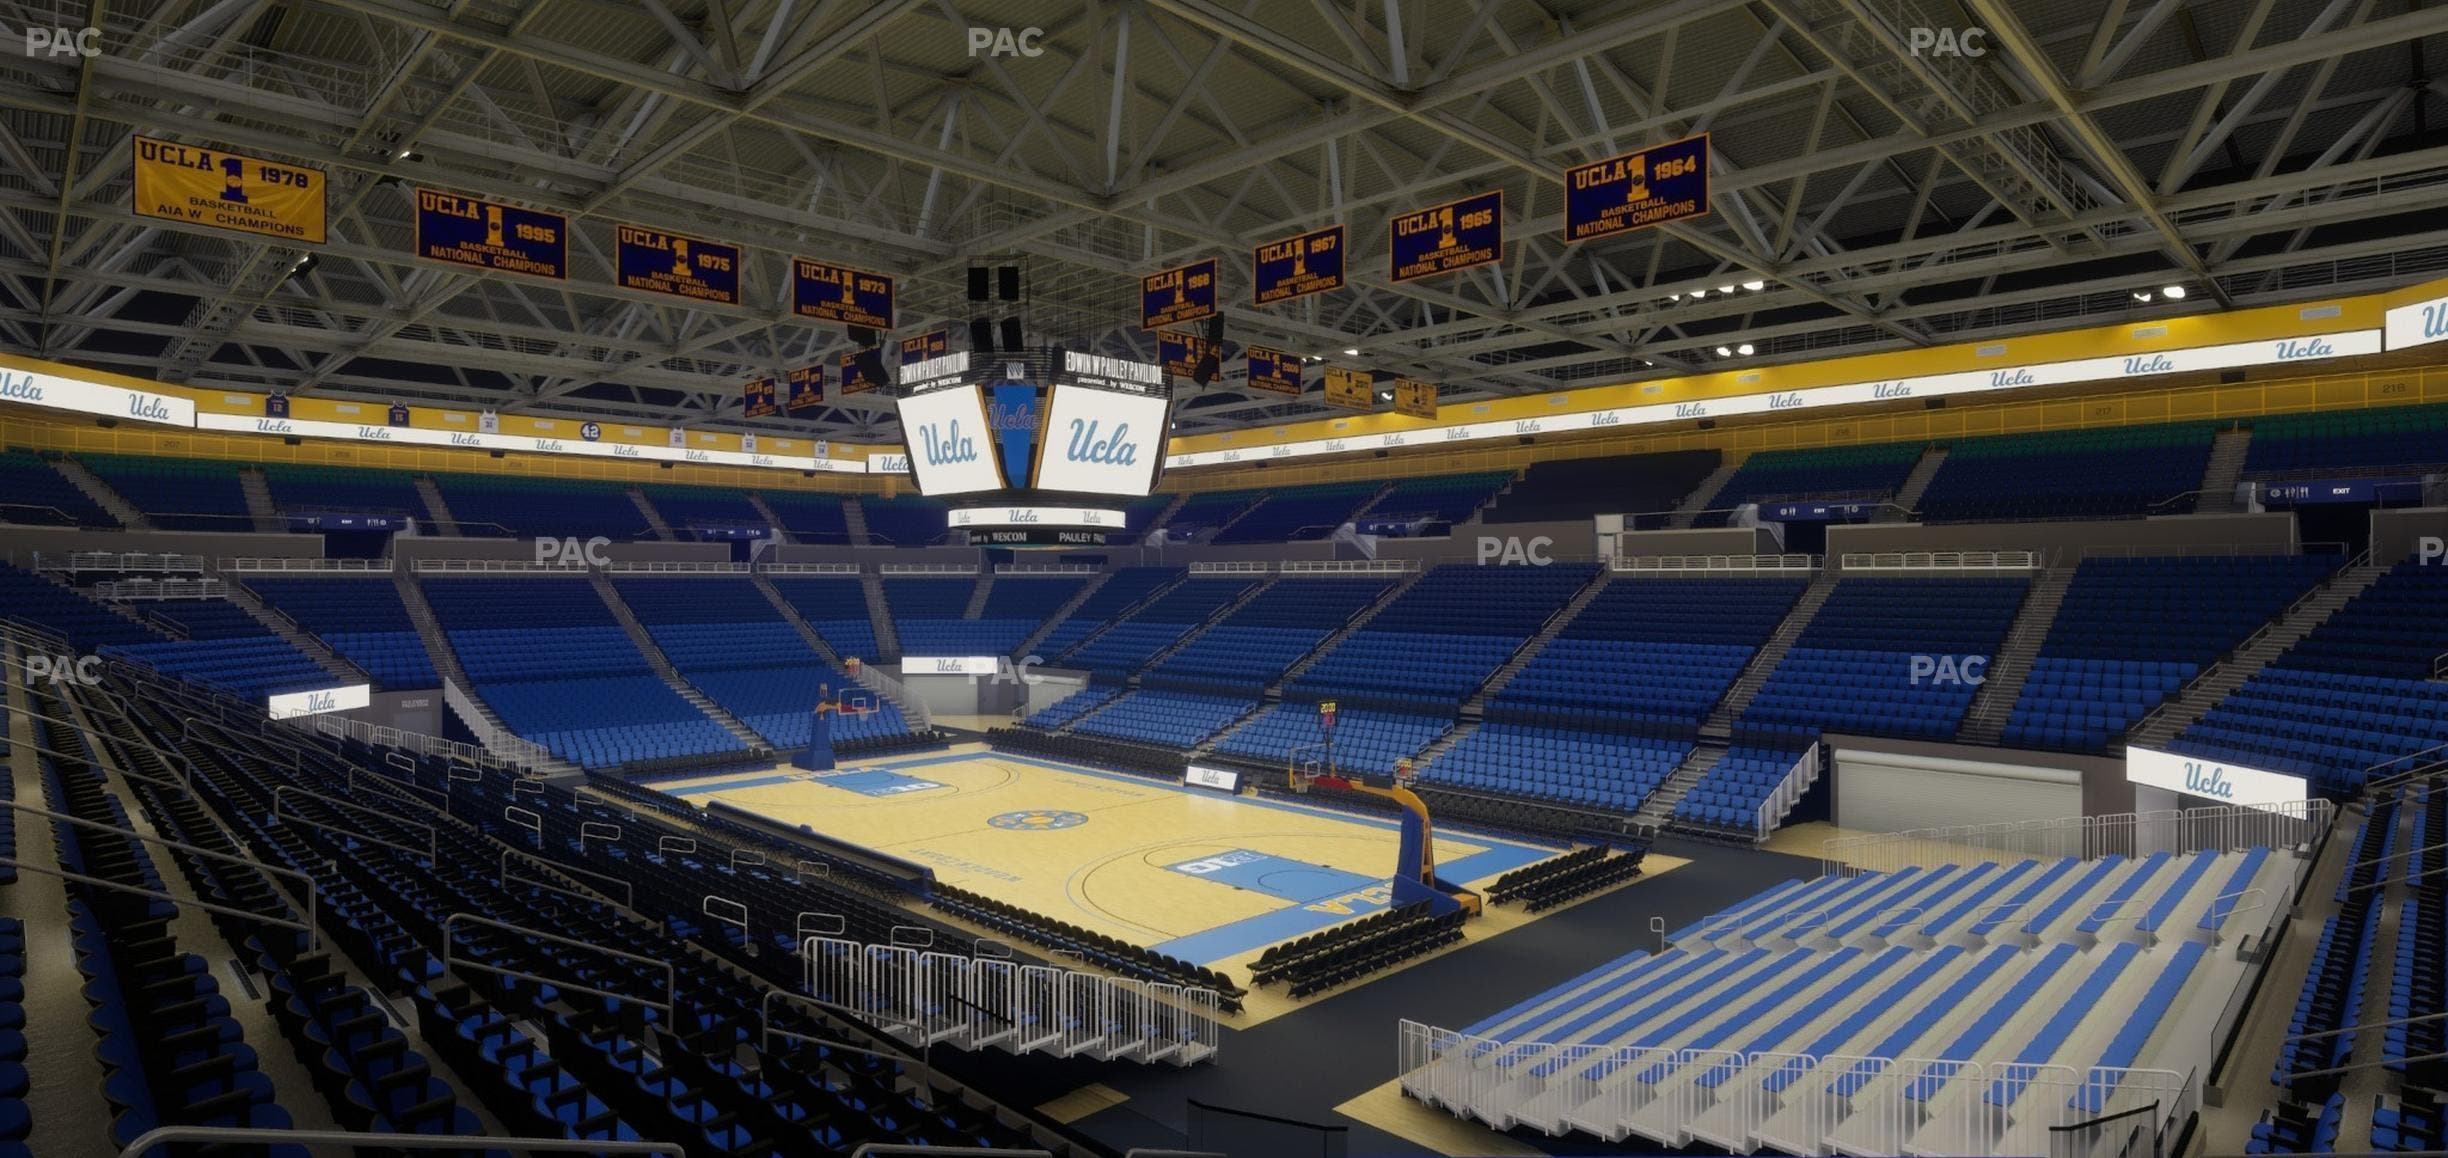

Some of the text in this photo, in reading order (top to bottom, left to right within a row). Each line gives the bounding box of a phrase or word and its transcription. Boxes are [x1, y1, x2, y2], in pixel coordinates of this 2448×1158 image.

[140, 141, 214, 172] UCLA
[259, 167, 309, 189] 1978
[1575, 160, 1626, 190] UCLA
[1654, 155, 1696, 180] 1964
[190, 197, 277, 219] BASKETBALL
[421, 192, 480, 220] UCLA
[516, 223, 555, 243] 1995
[1601, 196, 1667, 219] BASKETBALL
[215, 214, 305, 236] CHAMPIONS
[1398, 211, 1438, 236] UCLA
[1460, 208, 1492, 230] 1965
[1576, 200, 1696, 237] NATIONAL CHAMPIONS
[431, 245, 555, 275] NATIONAL CHAMPIONS
[460, 241, 528, 259] BASKETBALL
[621, 229, 669, 250] UCLA
[697, 254, 730, 272] 1975
[1261, 242, 1293, 264] UCLA
[1418, 245, 1470, 262] BASKETBALL
[1400, 248, 1492, 278] NATIONAL CHAMPIONS
[800, 264, 840, 284] UCLA
[1147, 273, 1174, 292] UCLA
[628, 275, 731, 301] NATIONAL CHAMPIONS
[2276, 338, 2333, 360] Ucla
[1065, 351, 1091, 374] EDWIN
[1092, 355, 1100, 375] W
[1100, 357, 1128, 379] PAULEY
[1129, 360, 1162, 384] PAVILION
[2123, 354, 2174, 375] Ucla
[1990, 369, 2034, 388] Ucla
[1873, 381, 1912, 398] Ucla
[129, 393, 170, 420] Ucla
[1675, 402, 1706, 418] Ucla
[1769, 392, 1804, 408] Ucla
[257, 419, 293, 433] Ucla
[1516, 420, 1540, 433] Ucla
[1591, 411, 1619, 426] Ucla
[358, 426, 391, 440] Ucla
[451, 433, 481, 446] Ucla
[582, 423, 600, 438] 42
[1446, 428, 1470, 440] Ucla
[535, 439, 563, 451] Ucla
[614, 445, 640, 456] Ucla
[920, 418, 977, 466] Ucla
[1067, 417, 1138, 466] Ucla
[1009, 509, 1038, 523] Ucla
[1059, 532, 1091, 543] PAULEY
[937, 658, 962, 672] Ucla
[308, 691, 336, 713] Ucla
[1201, 770, 1220, 785] Ucla
[2184, 762, 2233, 798] Ucla
